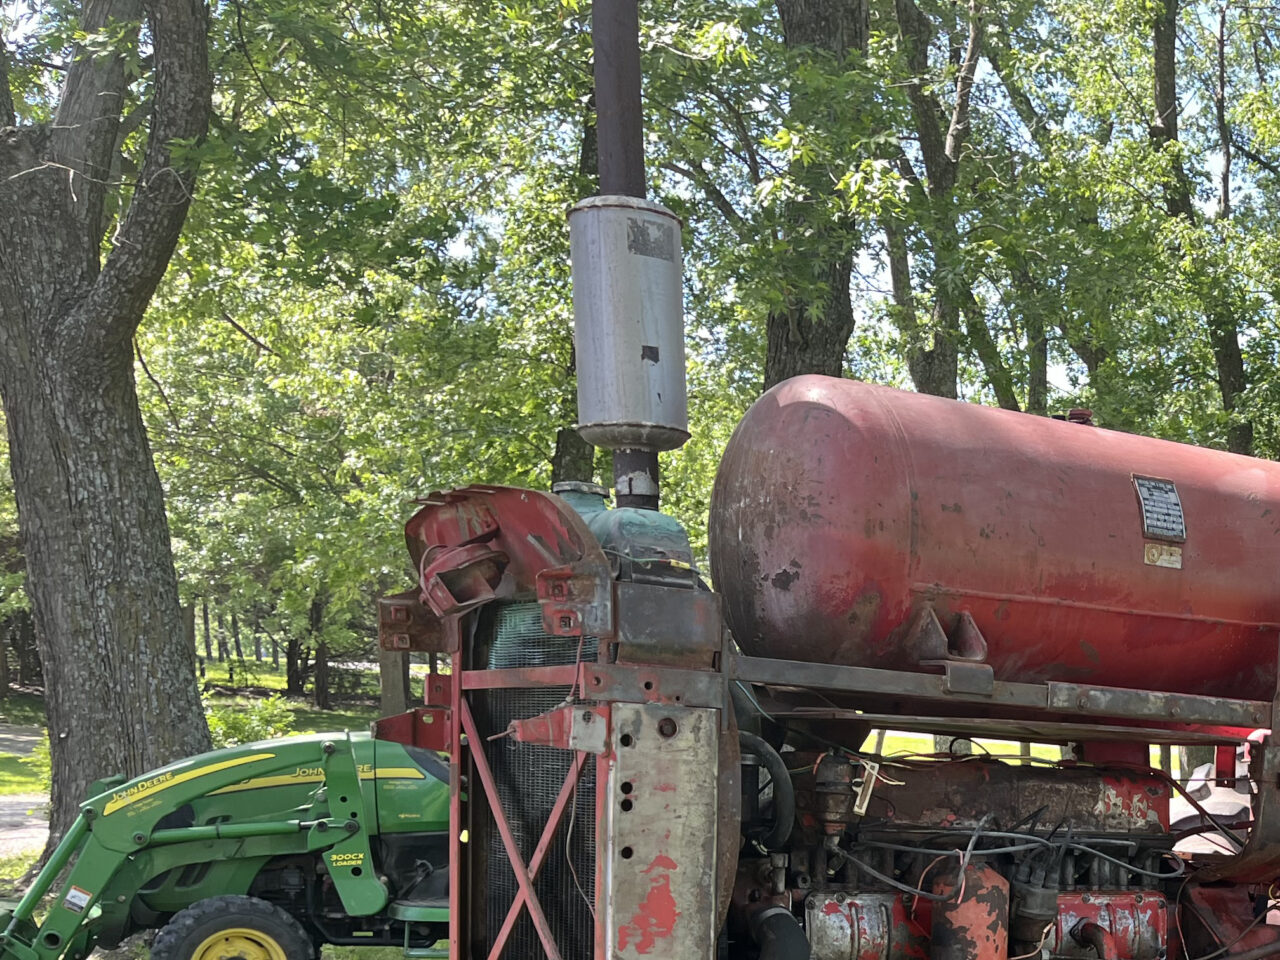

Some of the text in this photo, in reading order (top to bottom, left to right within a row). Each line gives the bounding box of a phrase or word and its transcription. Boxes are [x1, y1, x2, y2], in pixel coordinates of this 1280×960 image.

[292, 767, 326, 778] JOHN
[111, 771, 174, 803] JOHN DEERE
[331, 852, 365, 861] 300CX
[332, 859, 362, 867] LOADER
